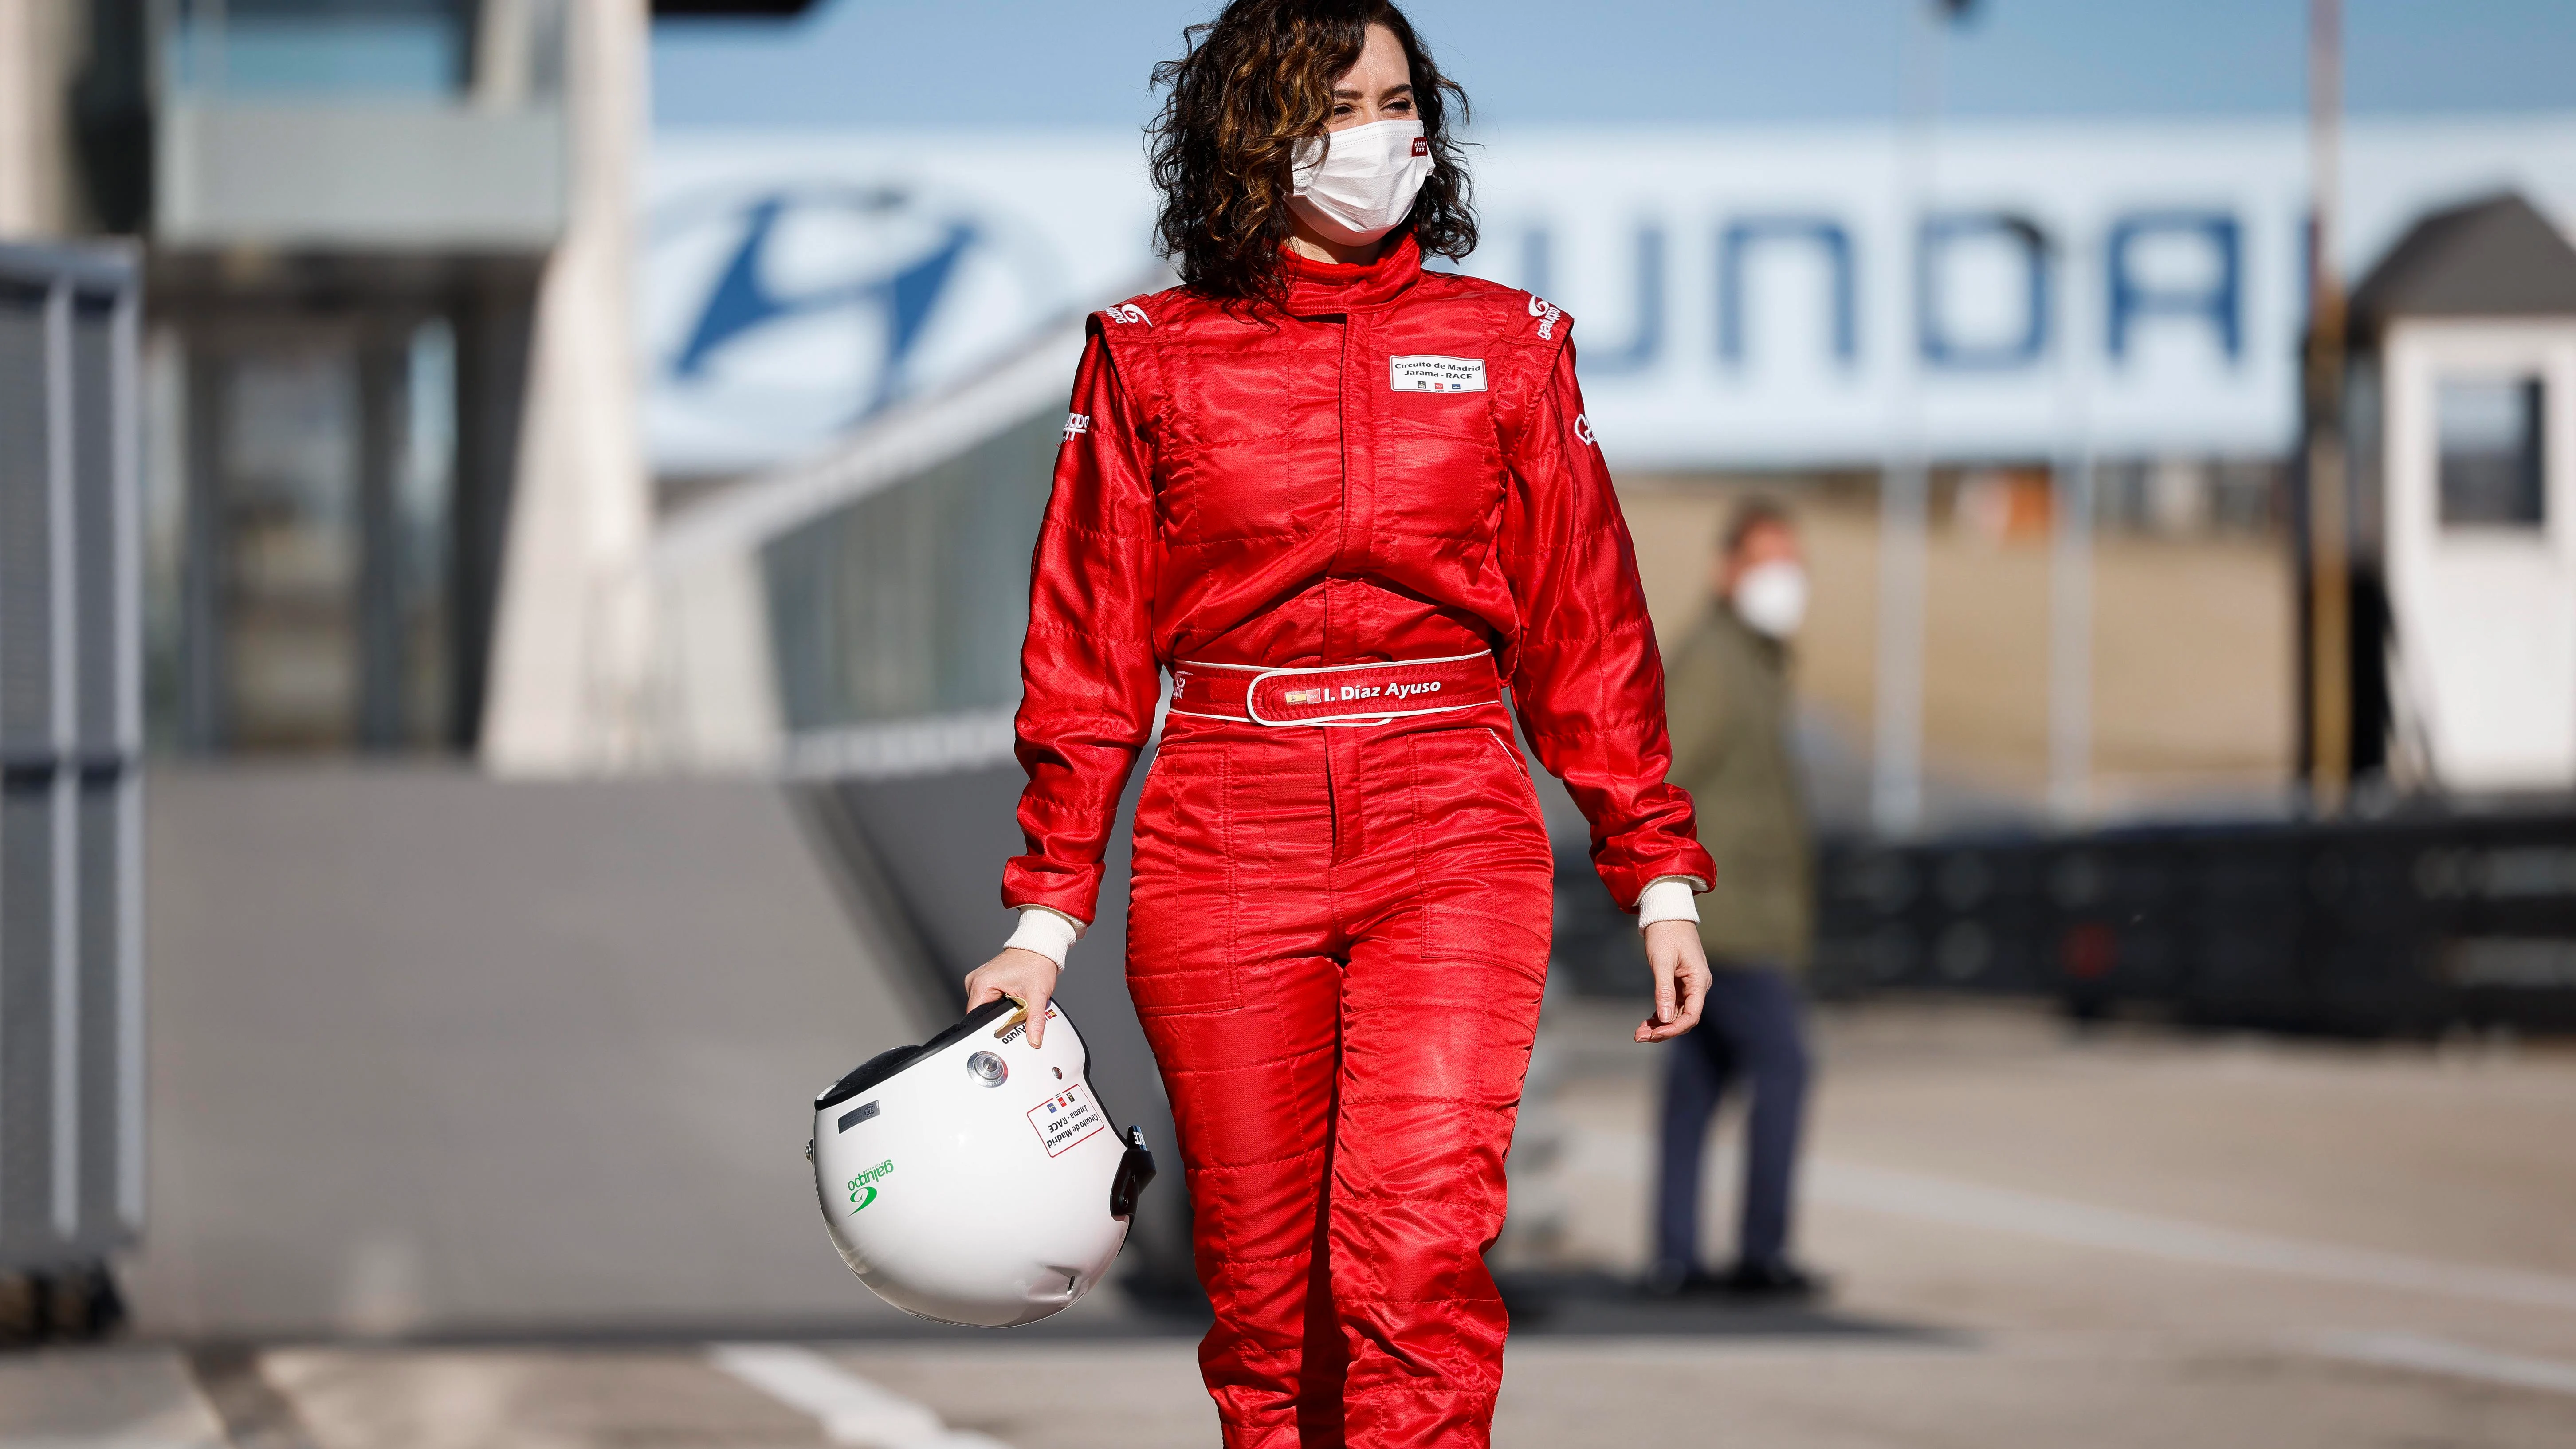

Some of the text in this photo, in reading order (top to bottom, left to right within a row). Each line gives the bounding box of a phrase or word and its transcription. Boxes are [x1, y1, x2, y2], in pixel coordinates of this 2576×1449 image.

[1324, 681, 1441, 702] I. Díaz Ayuso
[1002, 1024, 1026, 1044] Ayuso
[1070, 1104, 1088, 1119] Jarama
[1046, 1114, 1099, 1148] Circuito de Madrid
[1048, 1116, 1068, 1133] RACE
[848, 1159, 894, 1191] galuppo
